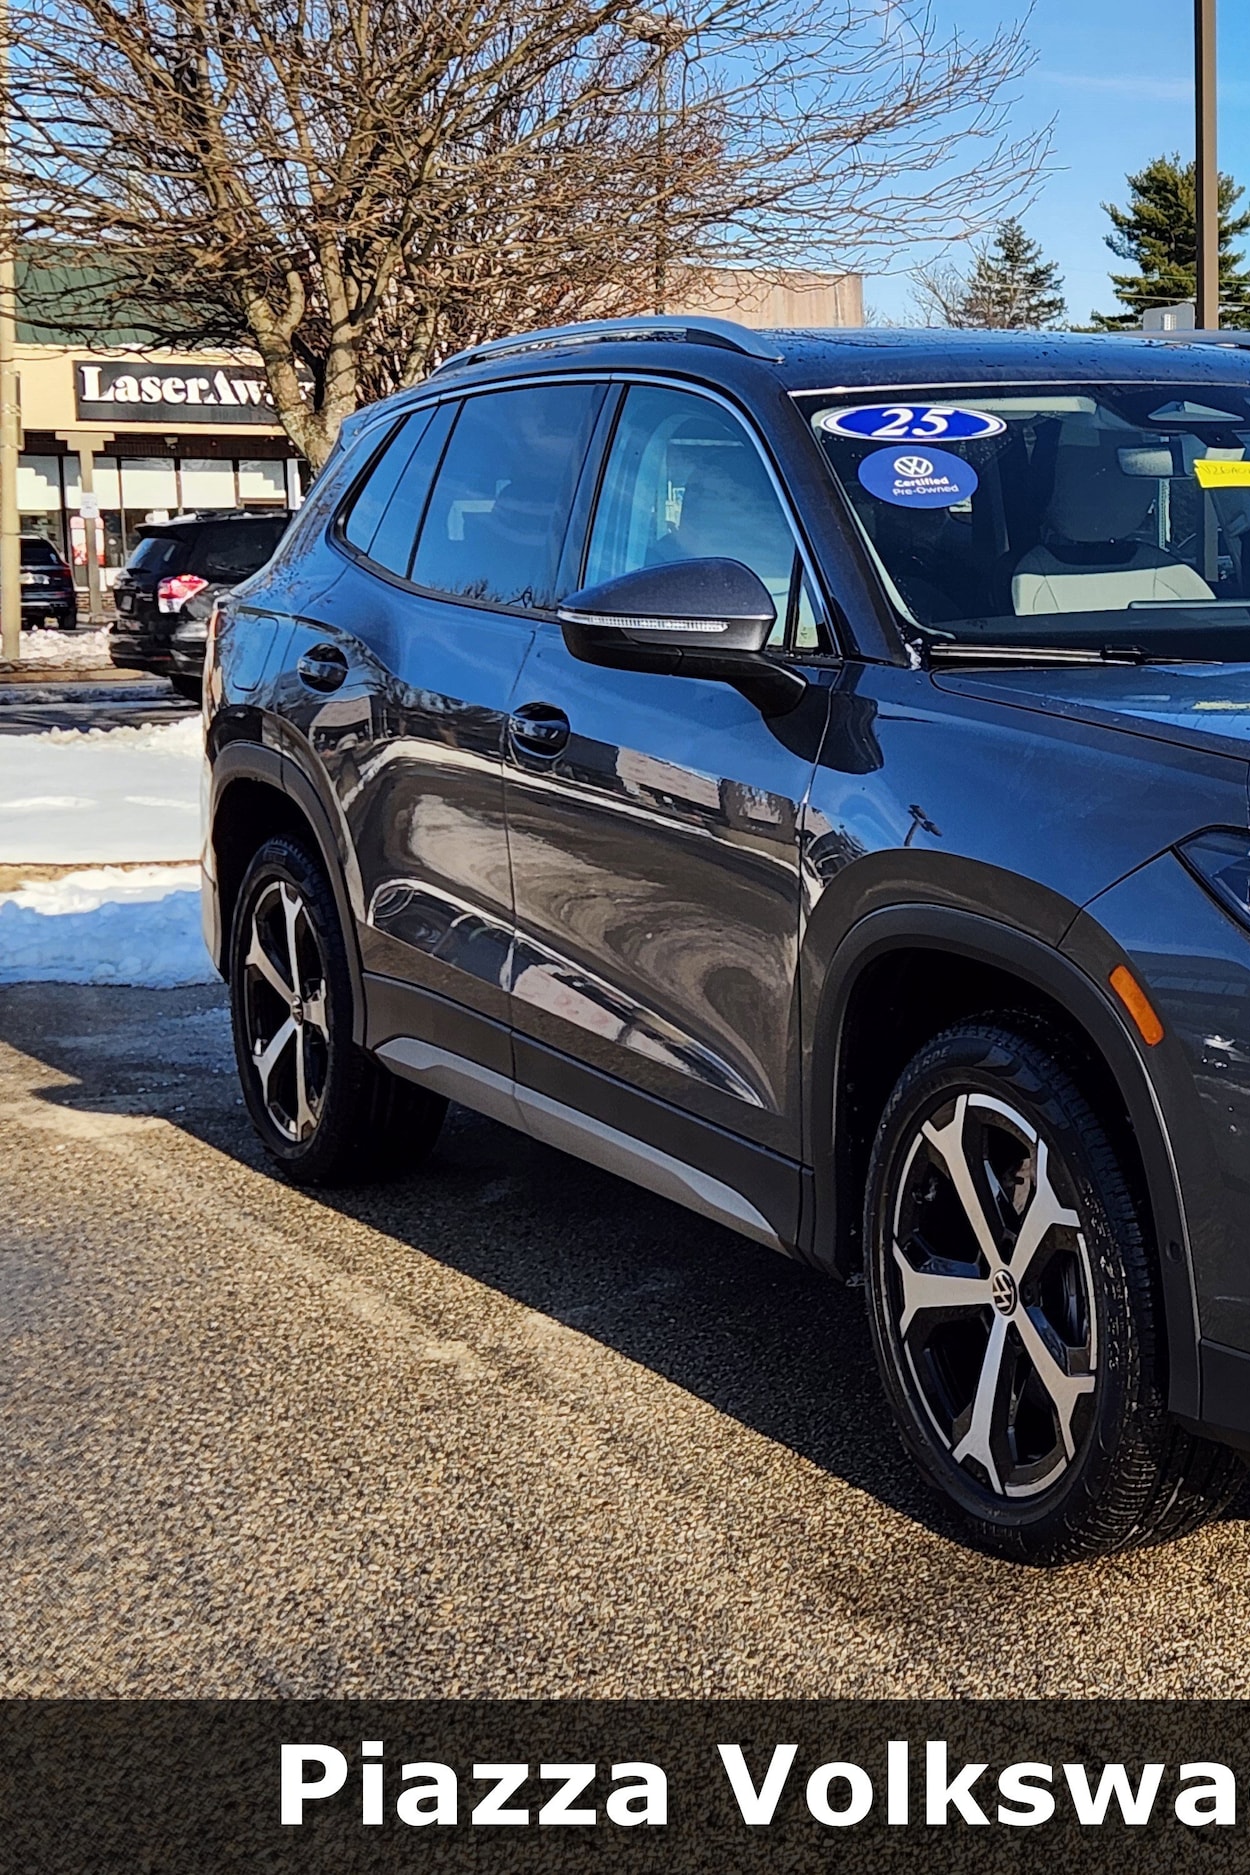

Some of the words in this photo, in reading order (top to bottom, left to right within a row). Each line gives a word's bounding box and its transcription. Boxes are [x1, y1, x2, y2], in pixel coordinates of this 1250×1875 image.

[80, 366, 315, 405] LaserAw
[871, 408, 955, 436] 25
[892, 484, 960, 496] Pre-Owned
[894, 476, 949, 487] Certified
